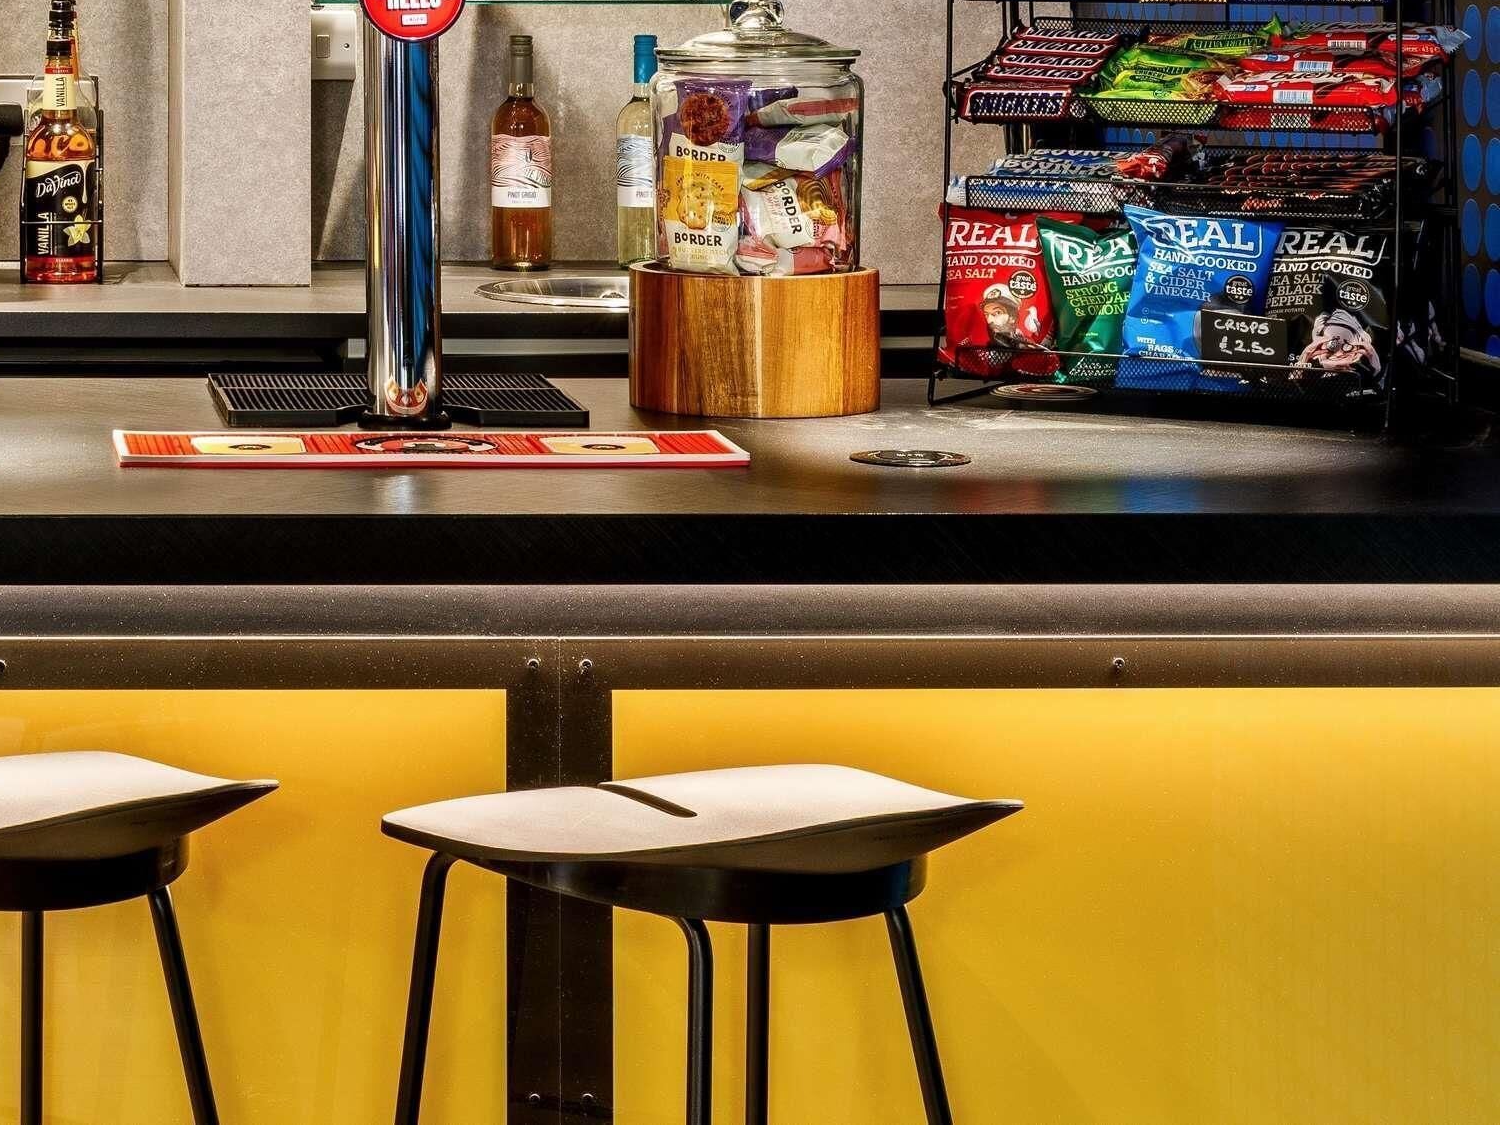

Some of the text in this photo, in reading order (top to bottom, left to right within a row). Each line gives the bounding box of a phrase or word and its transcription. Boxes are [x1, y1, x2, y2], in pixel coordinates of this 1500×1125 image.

[56, 77, 67, 107] VANILLA
[35, 170, 82, 198] DaVinci
[507, 191, 520, 199] PINOT
[38, 212, 51, 256] VANILLA
[674, 232, 723, 247] BORDER
[947, 221, 1038, 248] REAL
[1155, 219, 1255, 251] REAL
[1275, 230, 1375, 259] REAL
[980, 255, 1036, 268] COOKED
[1153, 248, 1257, 273] HAND COOKED
[947, 268, 996, 282] EA SALT
[1148, 261, 1215, 282] SEA SALT
[1310, 261, 1373, 280] COOKED
[1009, 280, 1037, 291] taste
[1062, 273, 1102, 287] HAND
[1145, 272, 1206, 291] & CIDER
[1269, 273, 1326, 287] EA SALT
[1065, 281, 1118, 300] STRONG
[1144, 282, 1212, 303] VINEGAR
[1225, 285, 1253, 296] taste
[1276, 284, 1323, 296] BLACK
[1339, 289, 1368, 303] taste
[1075, 304, 1125, 316] & ONION
[1266, 295, 1314, 309] PEPPER
[1214, 318, 1270, 335] CRISPS
